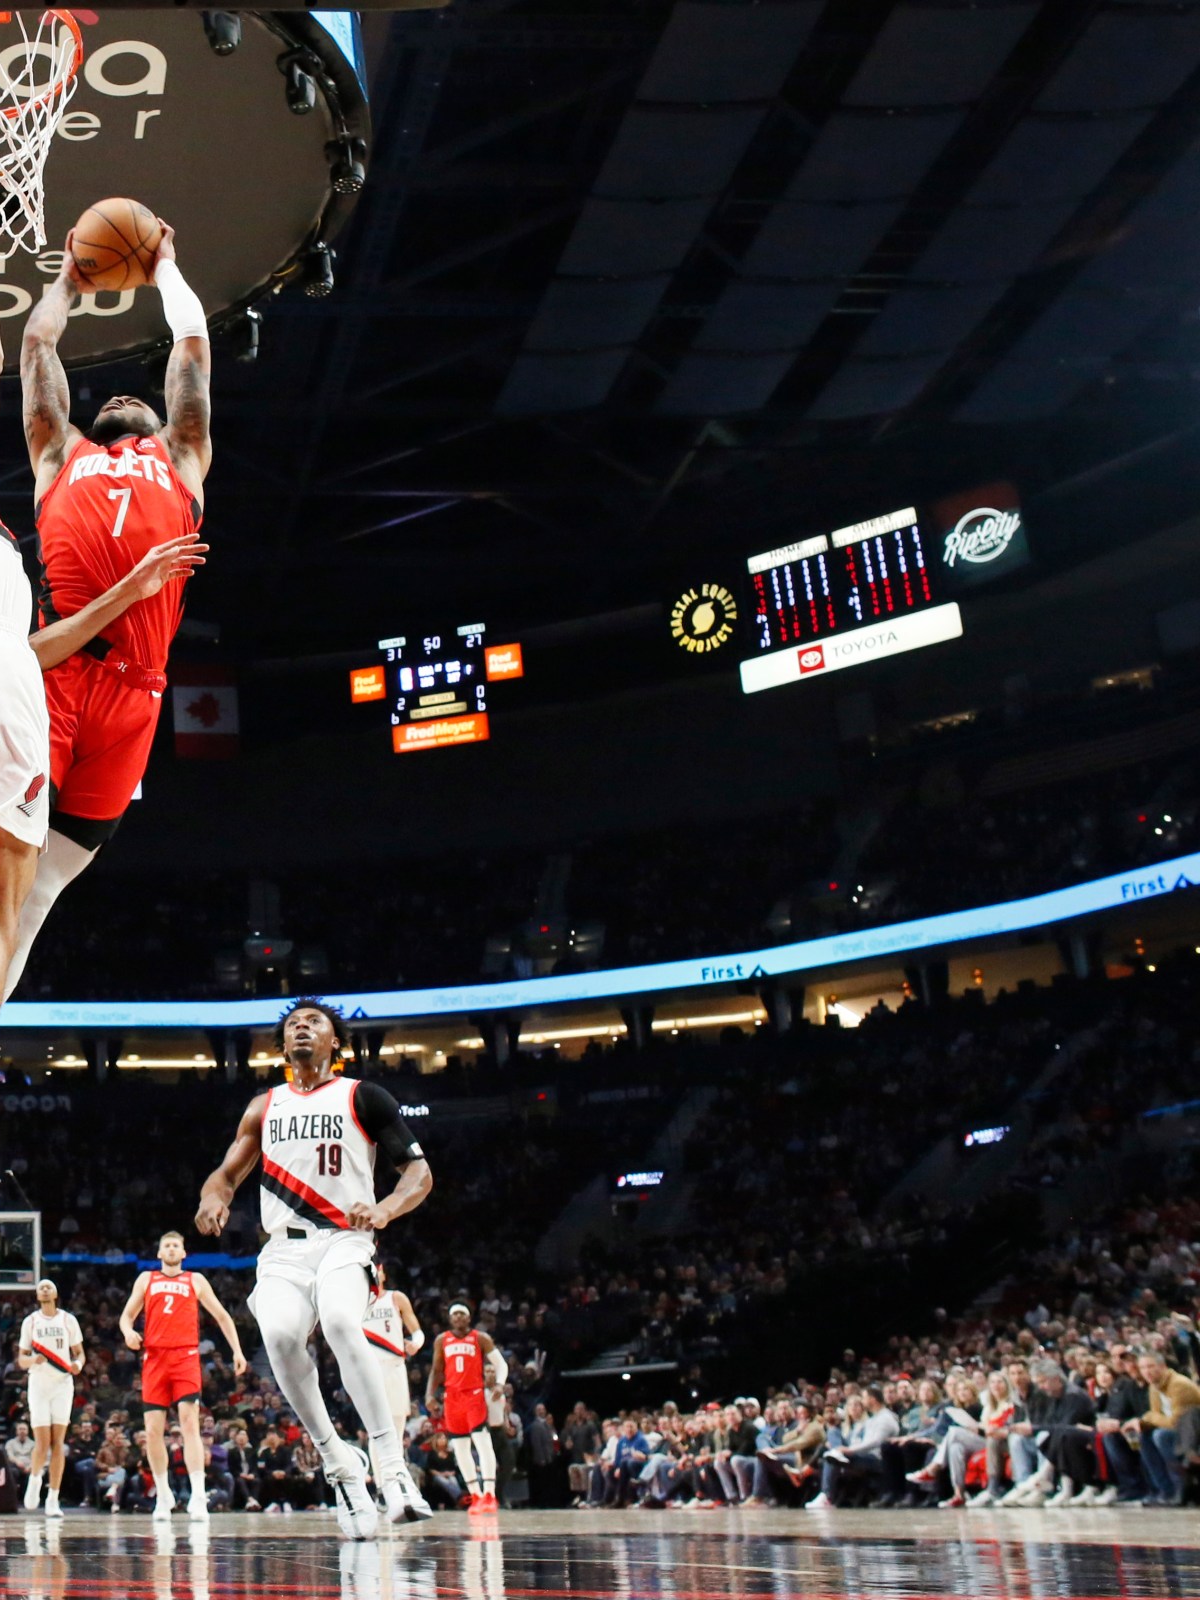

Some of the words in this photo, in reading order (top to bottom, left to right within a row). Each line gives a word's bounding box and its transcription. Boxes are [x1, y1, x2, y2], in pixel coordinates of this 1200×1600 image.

[68, 447, 171, 491] ROCKETS
[108, 487, 131, 537] 7
[670, 588, 698, 638] RACIAL
[702, 583, 737, 620] EQUITY
[466, 634, 482, 648] 27
[679, 623, 733, 653] PROJECT
[833, 631, 898, 657] TOYOTA
[387, 648, 402, 661] 31
[476, 685, 485, 698] 0
[397, 697, 406, 710] 2
[1120, 875, 1166, 900] First
[701, 964, 743, 980] First
[399, 1105, 429, 1116] Tech
[269, 1114, 343, 1144] BLAZERS
[316, 1143, 342, 1176] 19
[163, 1295, 174, 1314] 2
[455, 1356, 464, 1373] 0
